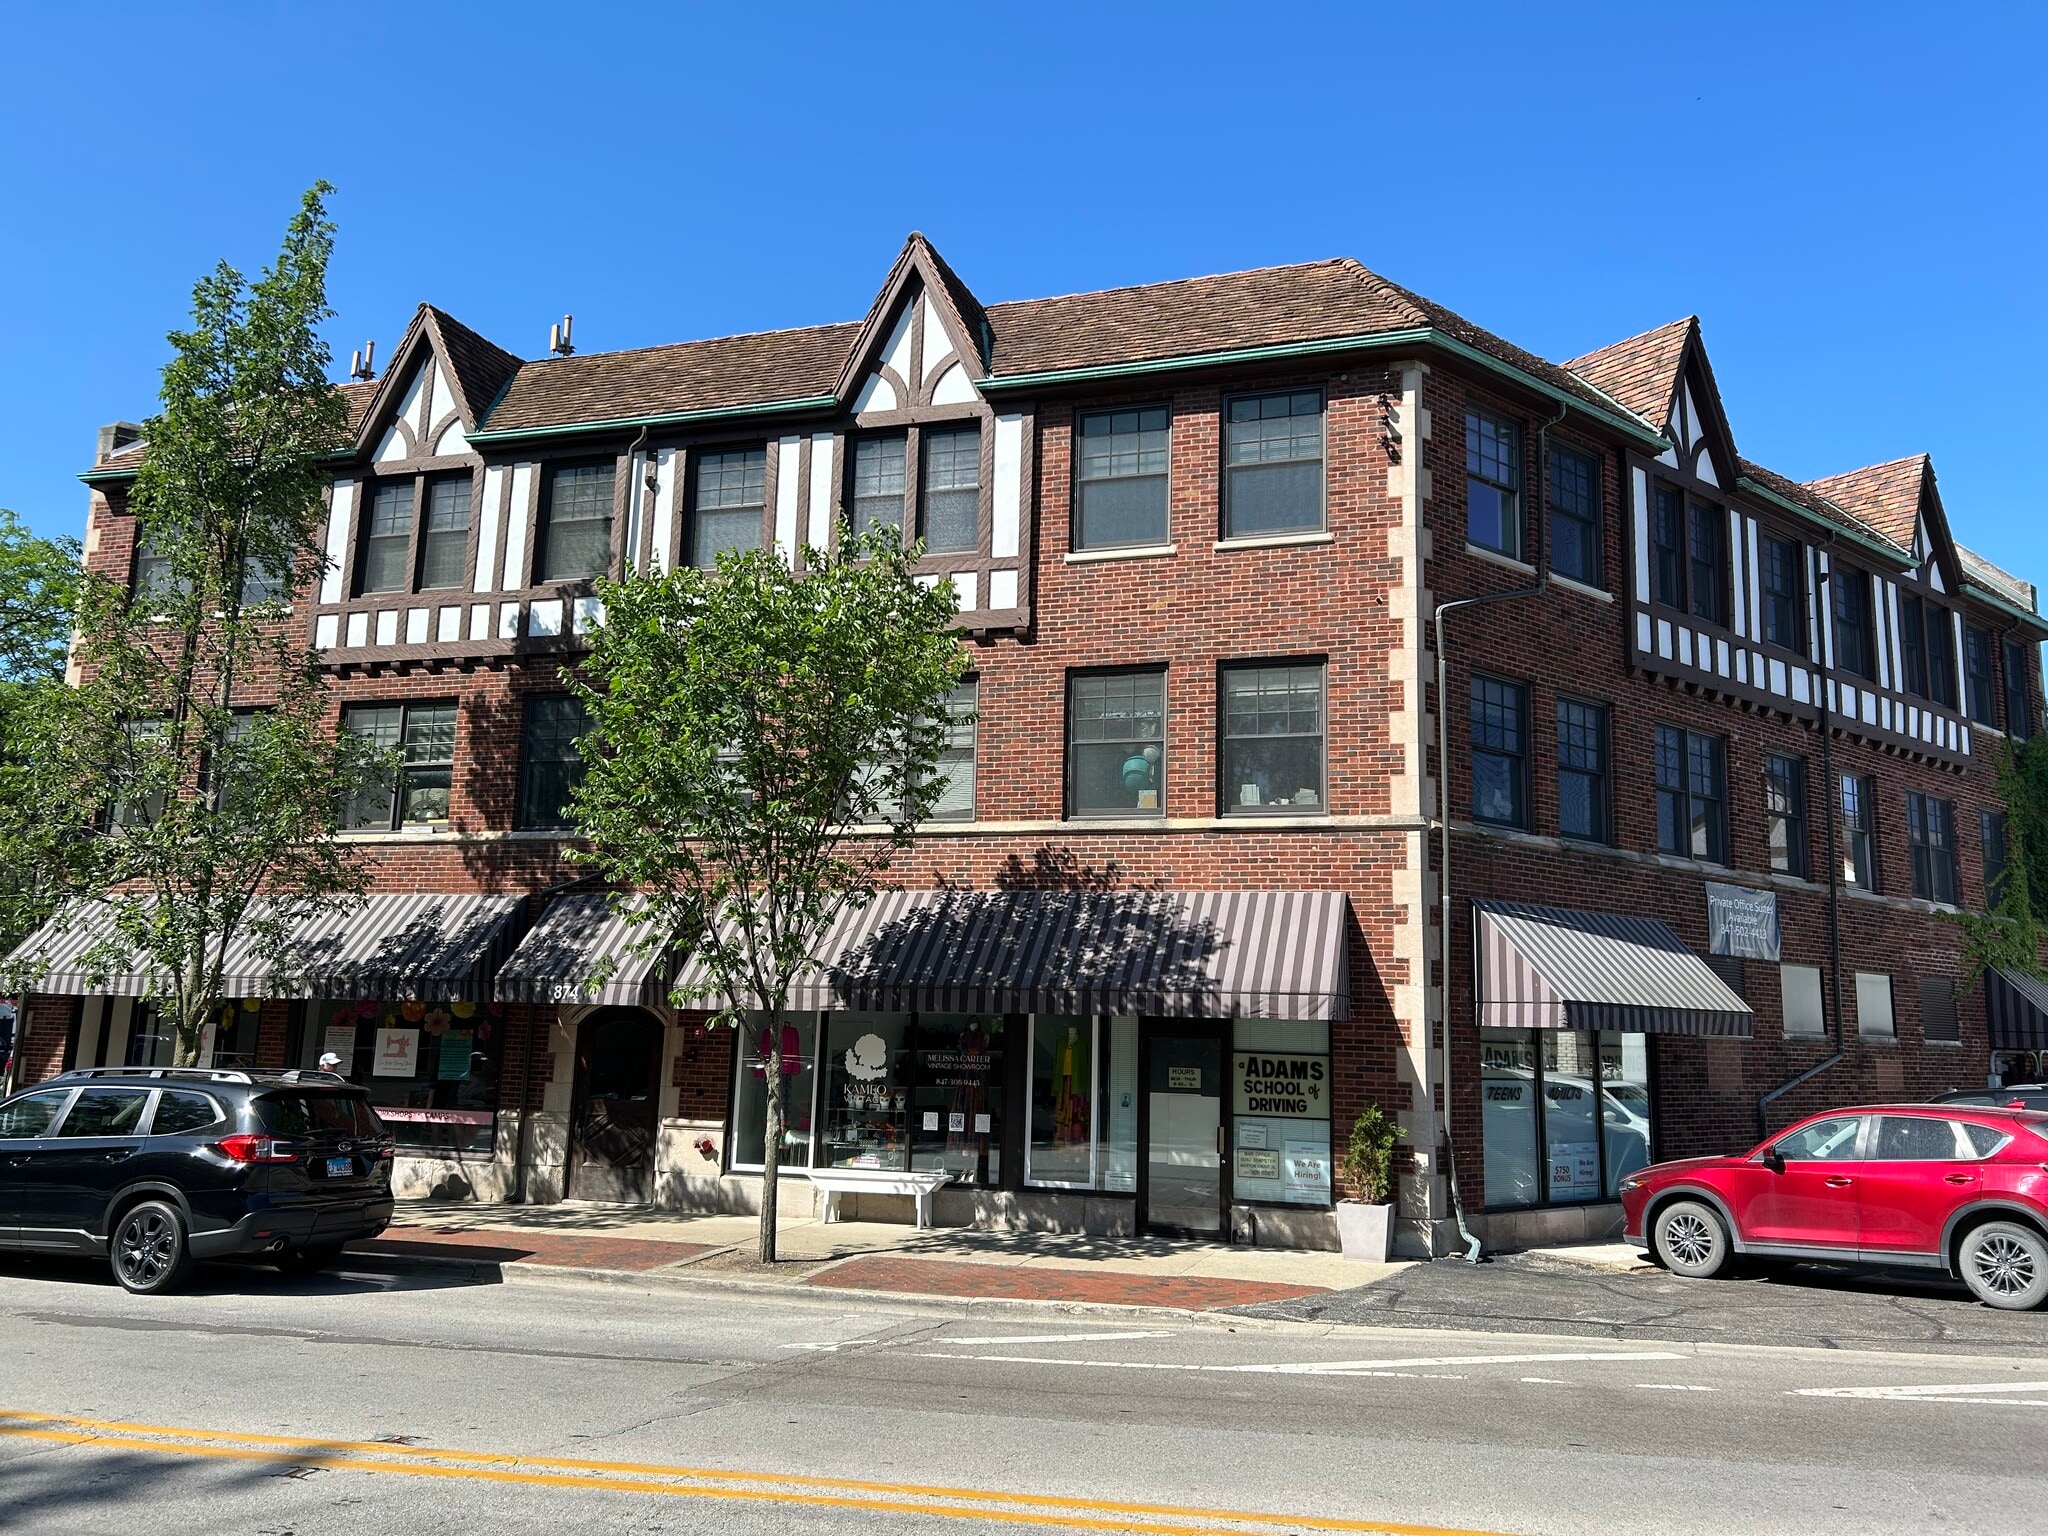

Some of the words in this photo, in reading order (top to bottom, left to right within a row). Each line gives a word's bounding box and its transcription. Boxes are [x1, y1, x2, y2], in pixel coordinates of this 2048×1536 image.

[1709, 895, 1733, 908] Private
[1733, 898, 1754, 912] Office
[1754, 902, 1774, 915] Suites
[1728, 911, 1758, 925] Available
[553, 984, 579, 1000] 874
[928, 1054, 959, 1062] MELISSA
[959, 1054, 991, 1063] CARTER
[927, 1062, 952, 1070] VINTAGE
[952, 1063, 991, 1071] SHOWROOM
[1245, 1056, 1324, 1081] ADAMS
[1243, 1080, 1305, 1096] SCHOOL
[1308, 1083, 1320, 1100] of
[1487, 1086, 1523, 1102] TEENS
[1549, 1086, 1583, 1100] ADULTS
[1248, 1096, 1308, 1113] DRIVING
[425, 1111, 450, 1120] CAMPS
[1293, 1159, 1306, 1168] We
[1307, 1160, 1321, 1169] Are
[1555, 1165, 1570, 1175] $750
[1294, 1170, 1321, 1181] Hiring!
[1553, 1174, 1571, 1183] BONUS
